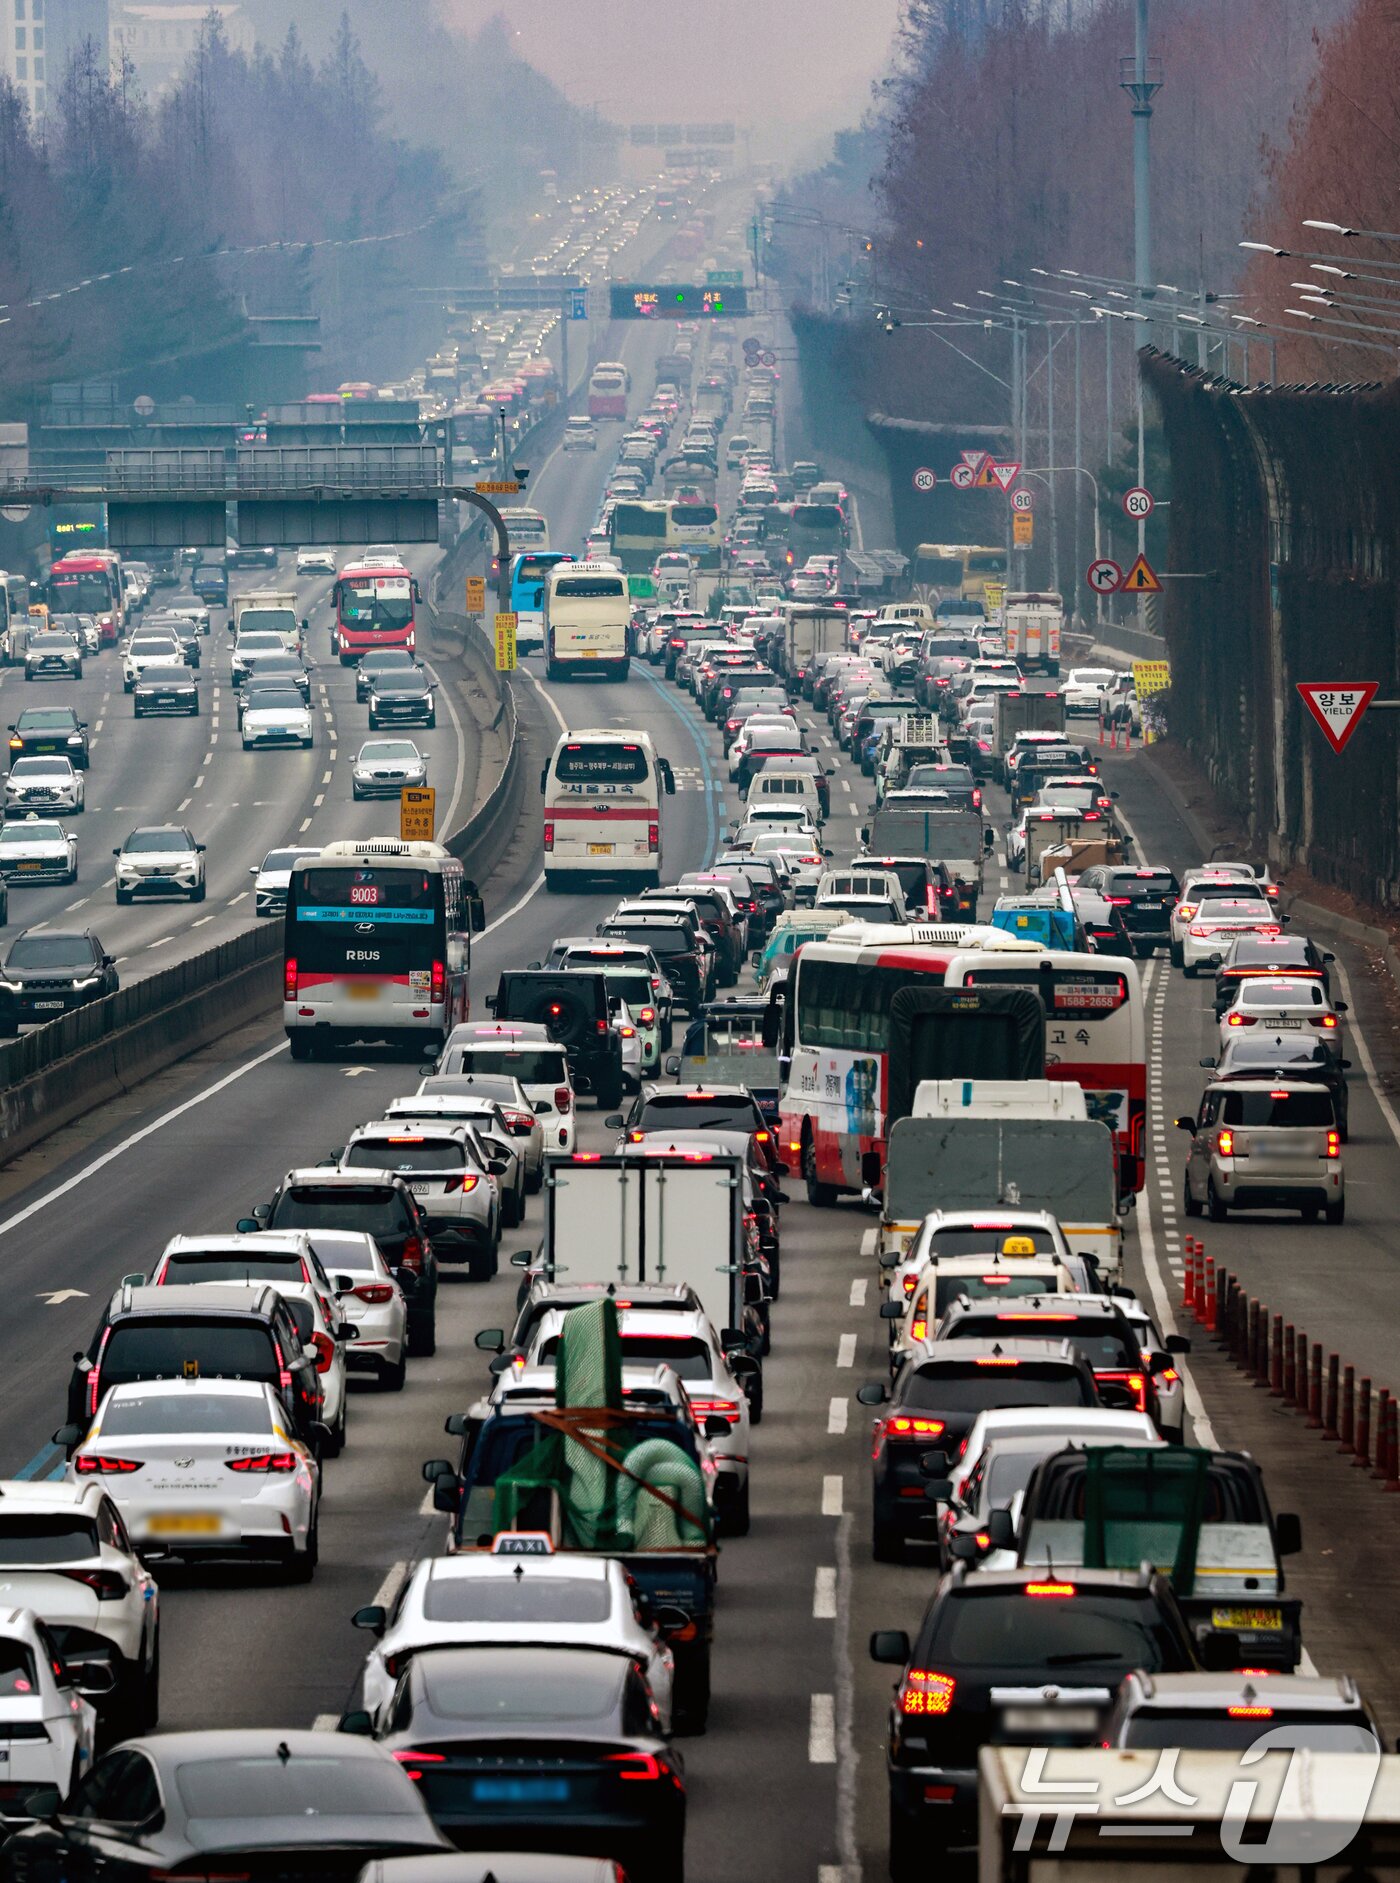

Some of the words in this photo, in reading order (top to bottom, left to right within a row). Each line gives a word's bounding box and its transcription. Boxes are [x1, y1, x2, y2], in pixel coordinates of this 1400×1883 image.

[917, 474, 932, 487] 80
[1016, 494, 1031, 507] 80
[1130, 497, 1148, 512] 80
[1319, 693, 1356, 707] 양보
[1322, 707, 1353, 716] YIELD
[568, 784, 634, 794] 서울고속
[351, 887, 378, 903] 9003
[1061, 996, 1114, 1008] 1588-2658
[503, 1540, 543, 1552] TAXI
